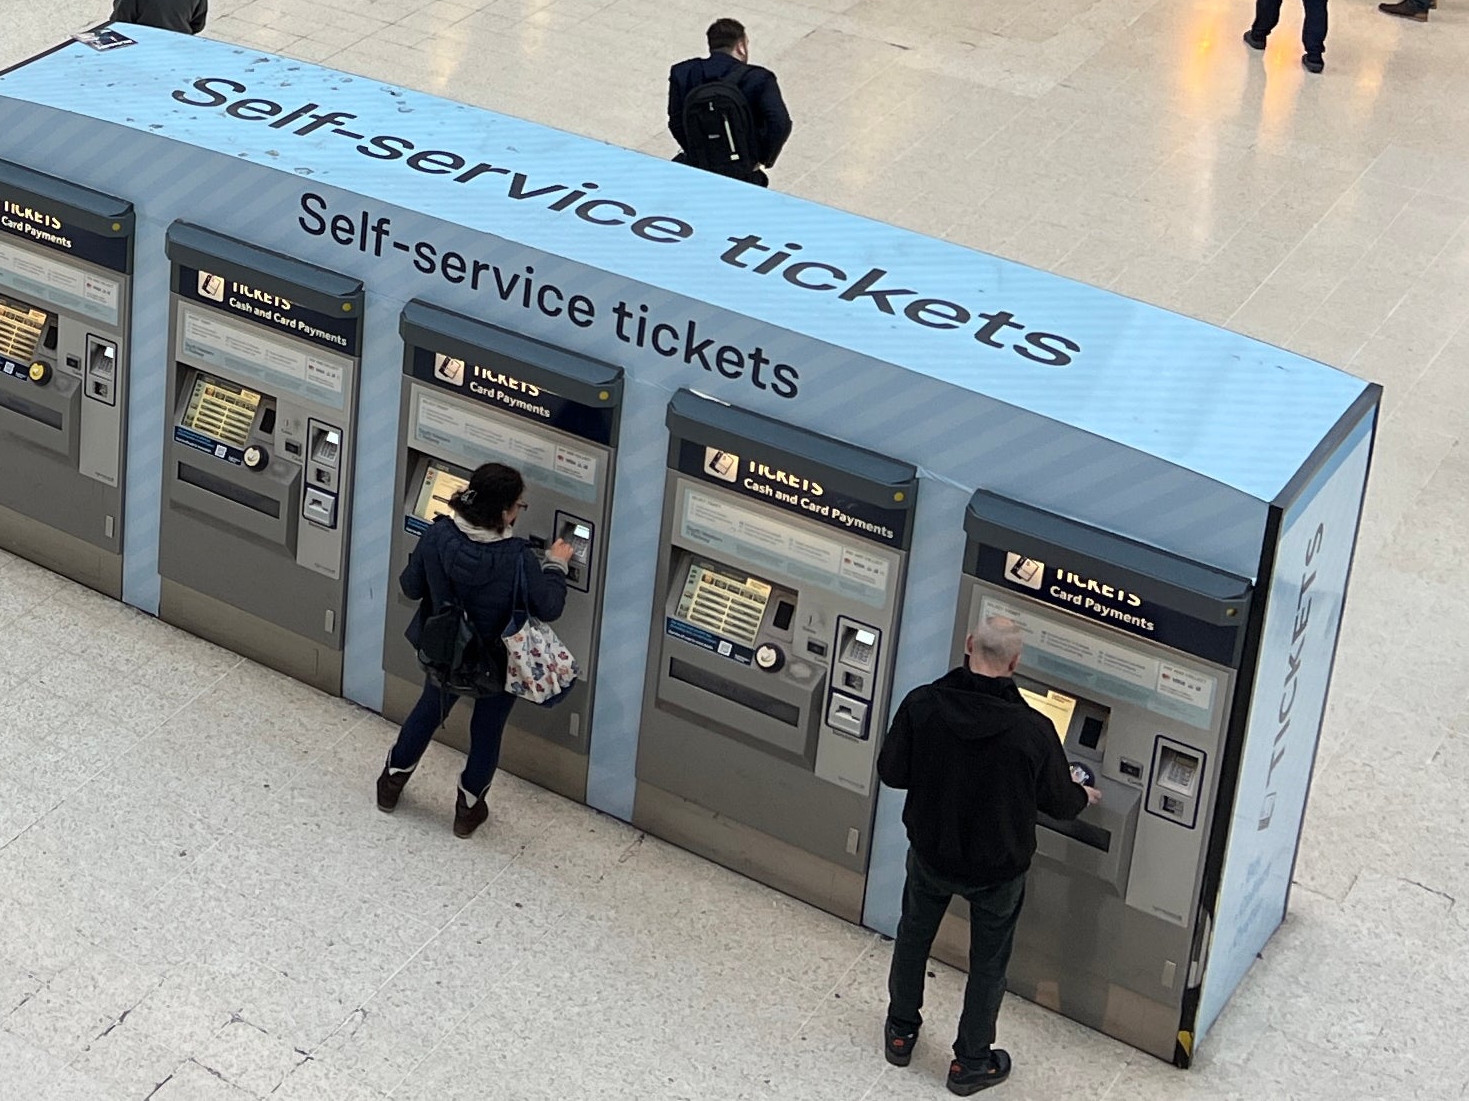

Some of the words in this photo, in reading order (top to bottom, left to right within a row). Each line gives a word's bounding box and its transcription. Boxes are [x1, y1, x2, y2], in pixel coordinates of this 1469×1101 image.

[1, 215, 24, 231] Card
[24, 223, 72, 248] Payments
[171, 76, 694, 245] Self-service
[727, 231, 1083, 368] tickets
[229, 297, 253, 313] Cash
[254, 306, 272, 320] and
[273, 313, 297, 329] Card
[298, 320, 347, 346] Payments
[298, 189, 596, 330] Self-service
[613, 298, 801, 400] tickets
[469, 381, 495, 399] Card
[496, 391, 551, 418] Payments
[744, 478, 773, 497] Cash
[775, 488, 798, 506] and
[800, 498, 829, 517] Card
[831, 507, 894, 539] Payments
[1049, 585, 1082, 606] Card
[1084, 597, 1155, 632] Payments
[1266, 522, 1325, 794] TICKETS
